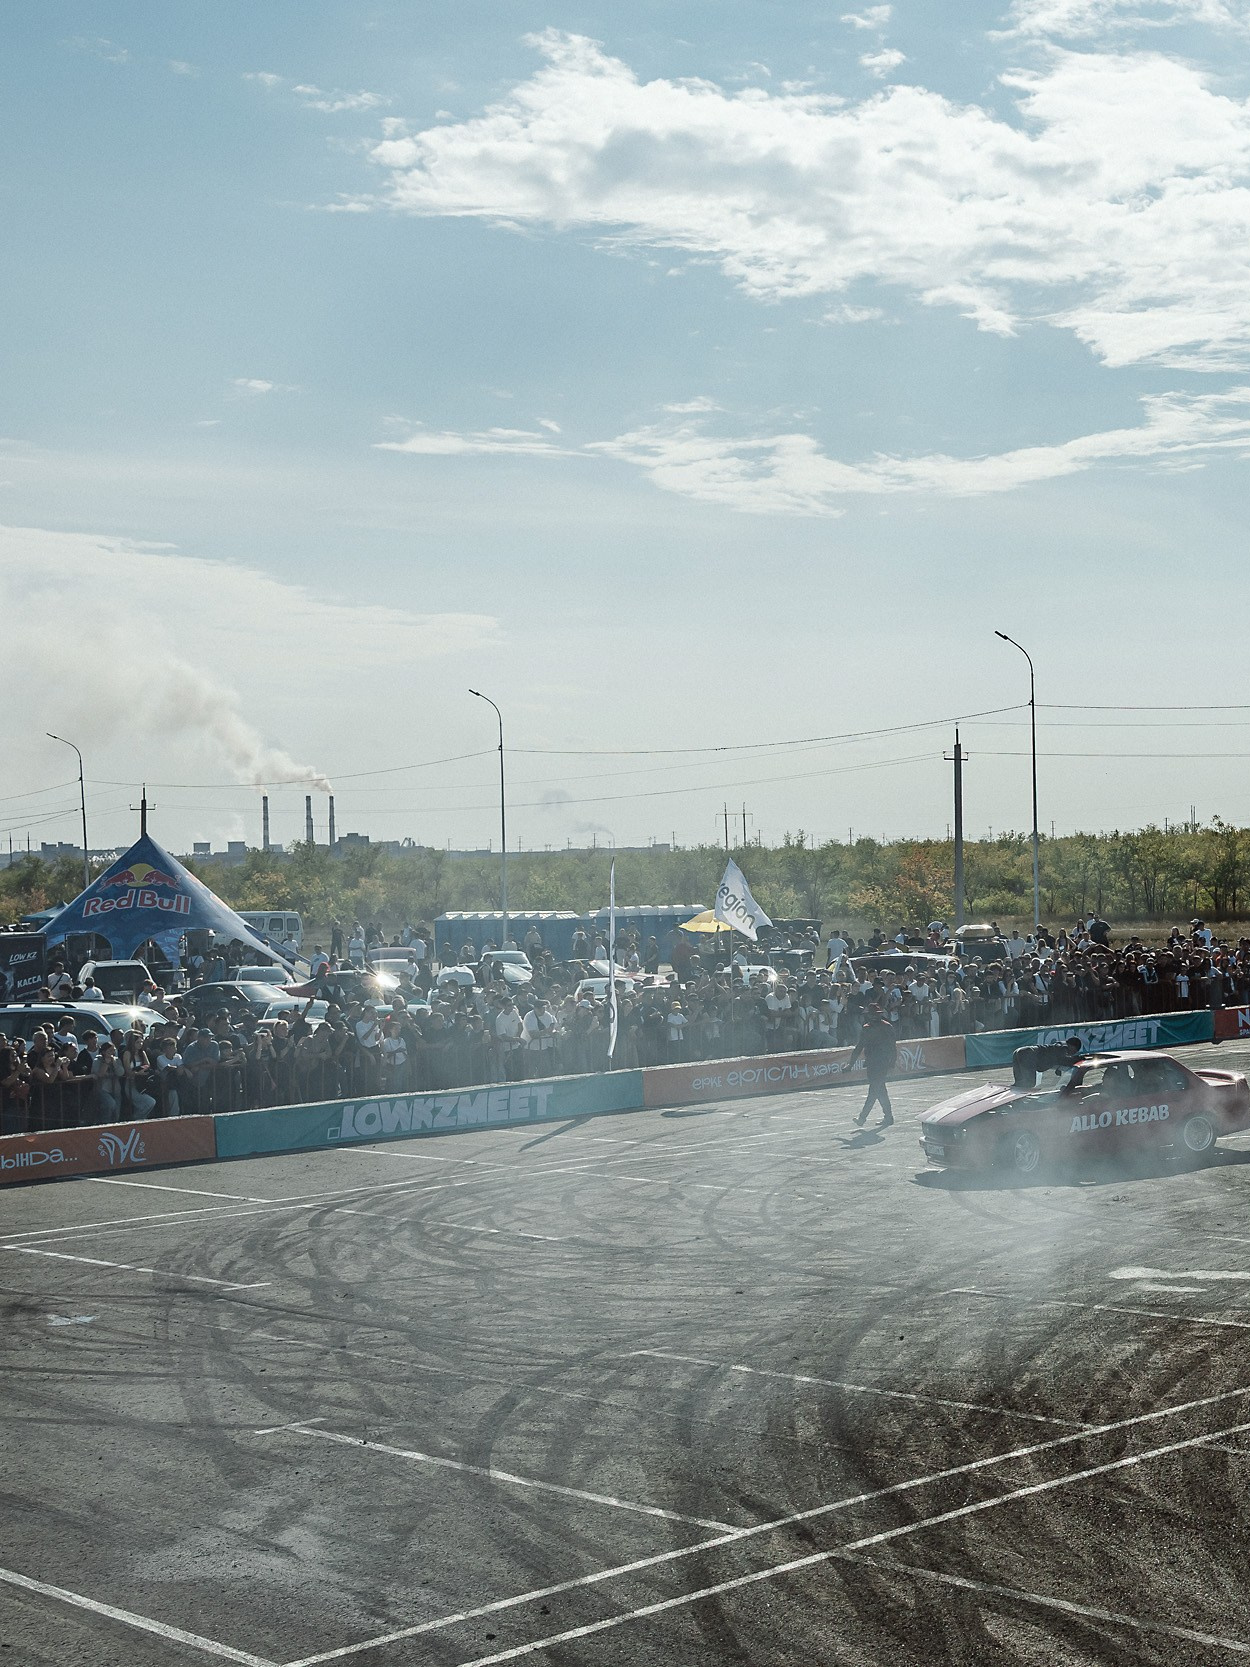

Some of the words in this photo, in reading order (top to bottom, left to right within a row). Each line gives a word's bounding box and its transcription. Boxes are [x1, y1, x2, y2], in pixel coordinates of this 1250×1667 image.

[82, 889, 136, 918] Red
[137, 889, 191, 915] Bull
[17, 975, 42, 988] КАССА
[1070, 1111, 1113, 1133] ALLO
[1115, 1104, 1170, 1126] KEBAB
